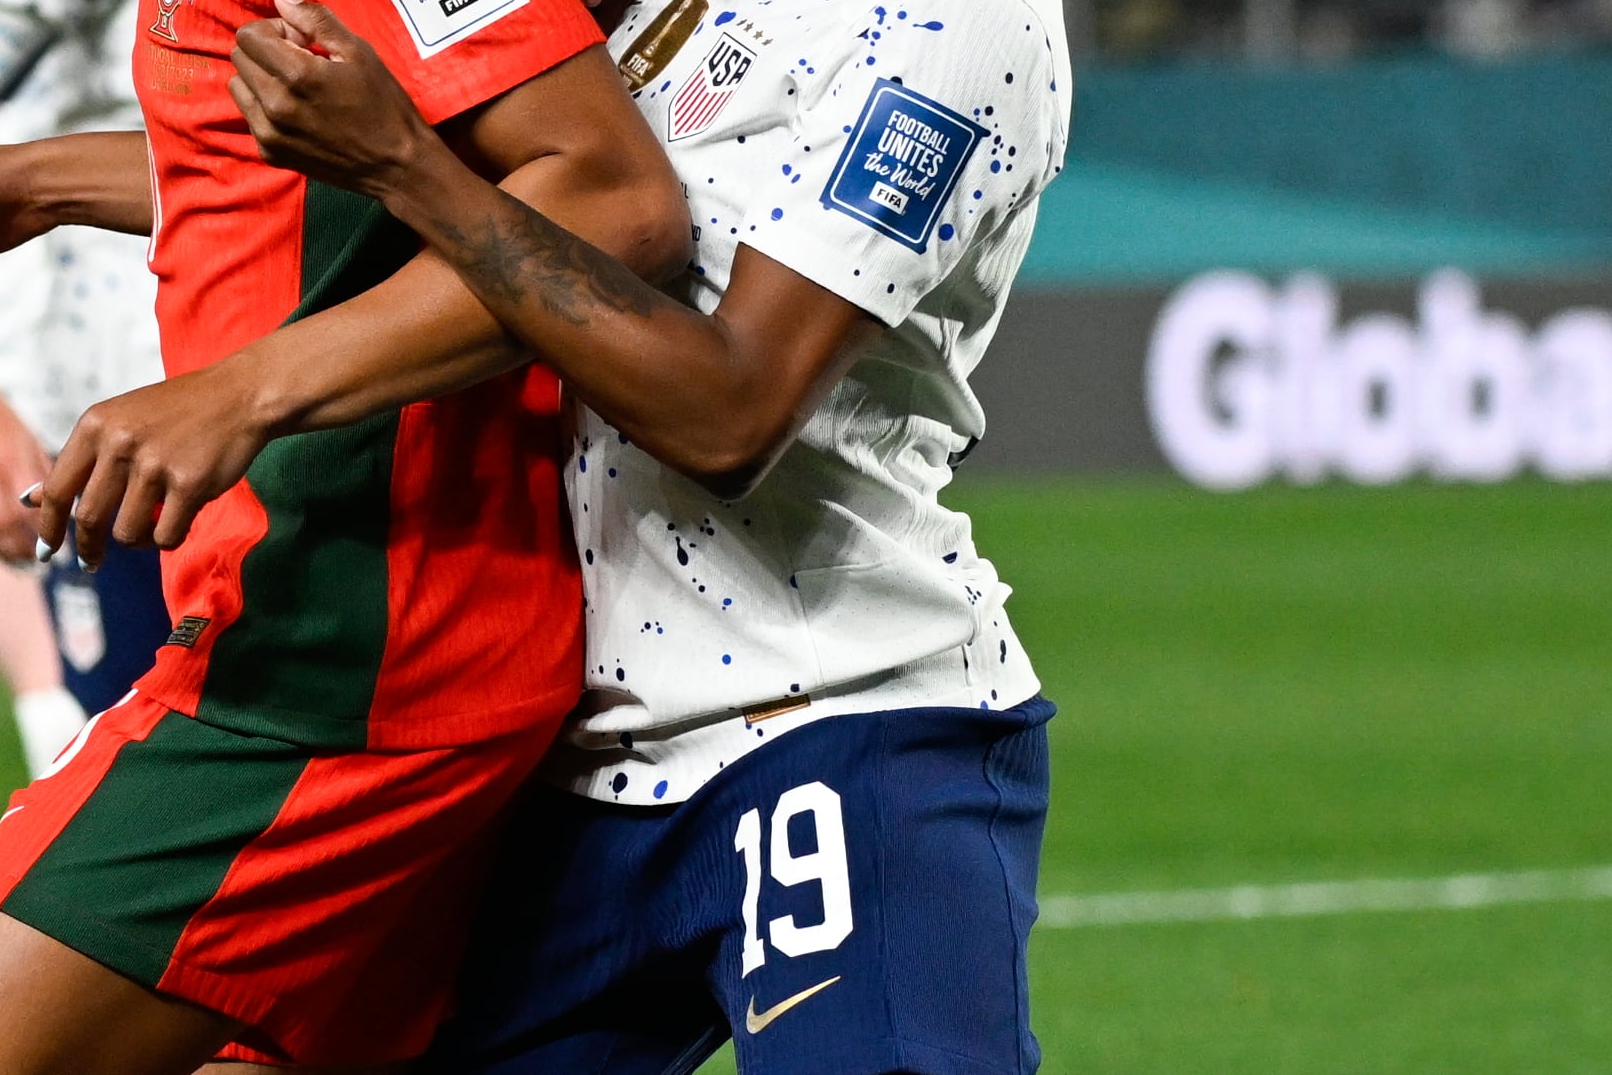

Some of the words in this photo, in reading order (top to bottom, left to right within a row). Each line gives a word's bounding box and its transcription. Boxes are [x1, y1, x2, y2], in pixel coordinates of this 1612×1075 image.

[627, 53, 649, 76] FIFA
[708, 41, 752, 87] USA
[878, 127, 943, 177] UNITES
[888, 110, 950, 155] FOOTBALL
[864, 153, 890, 176] the
[890, 163, 936, 201] World
[877, 189, 902, 208] FIFA
[734, 781, 853, 978] 19
